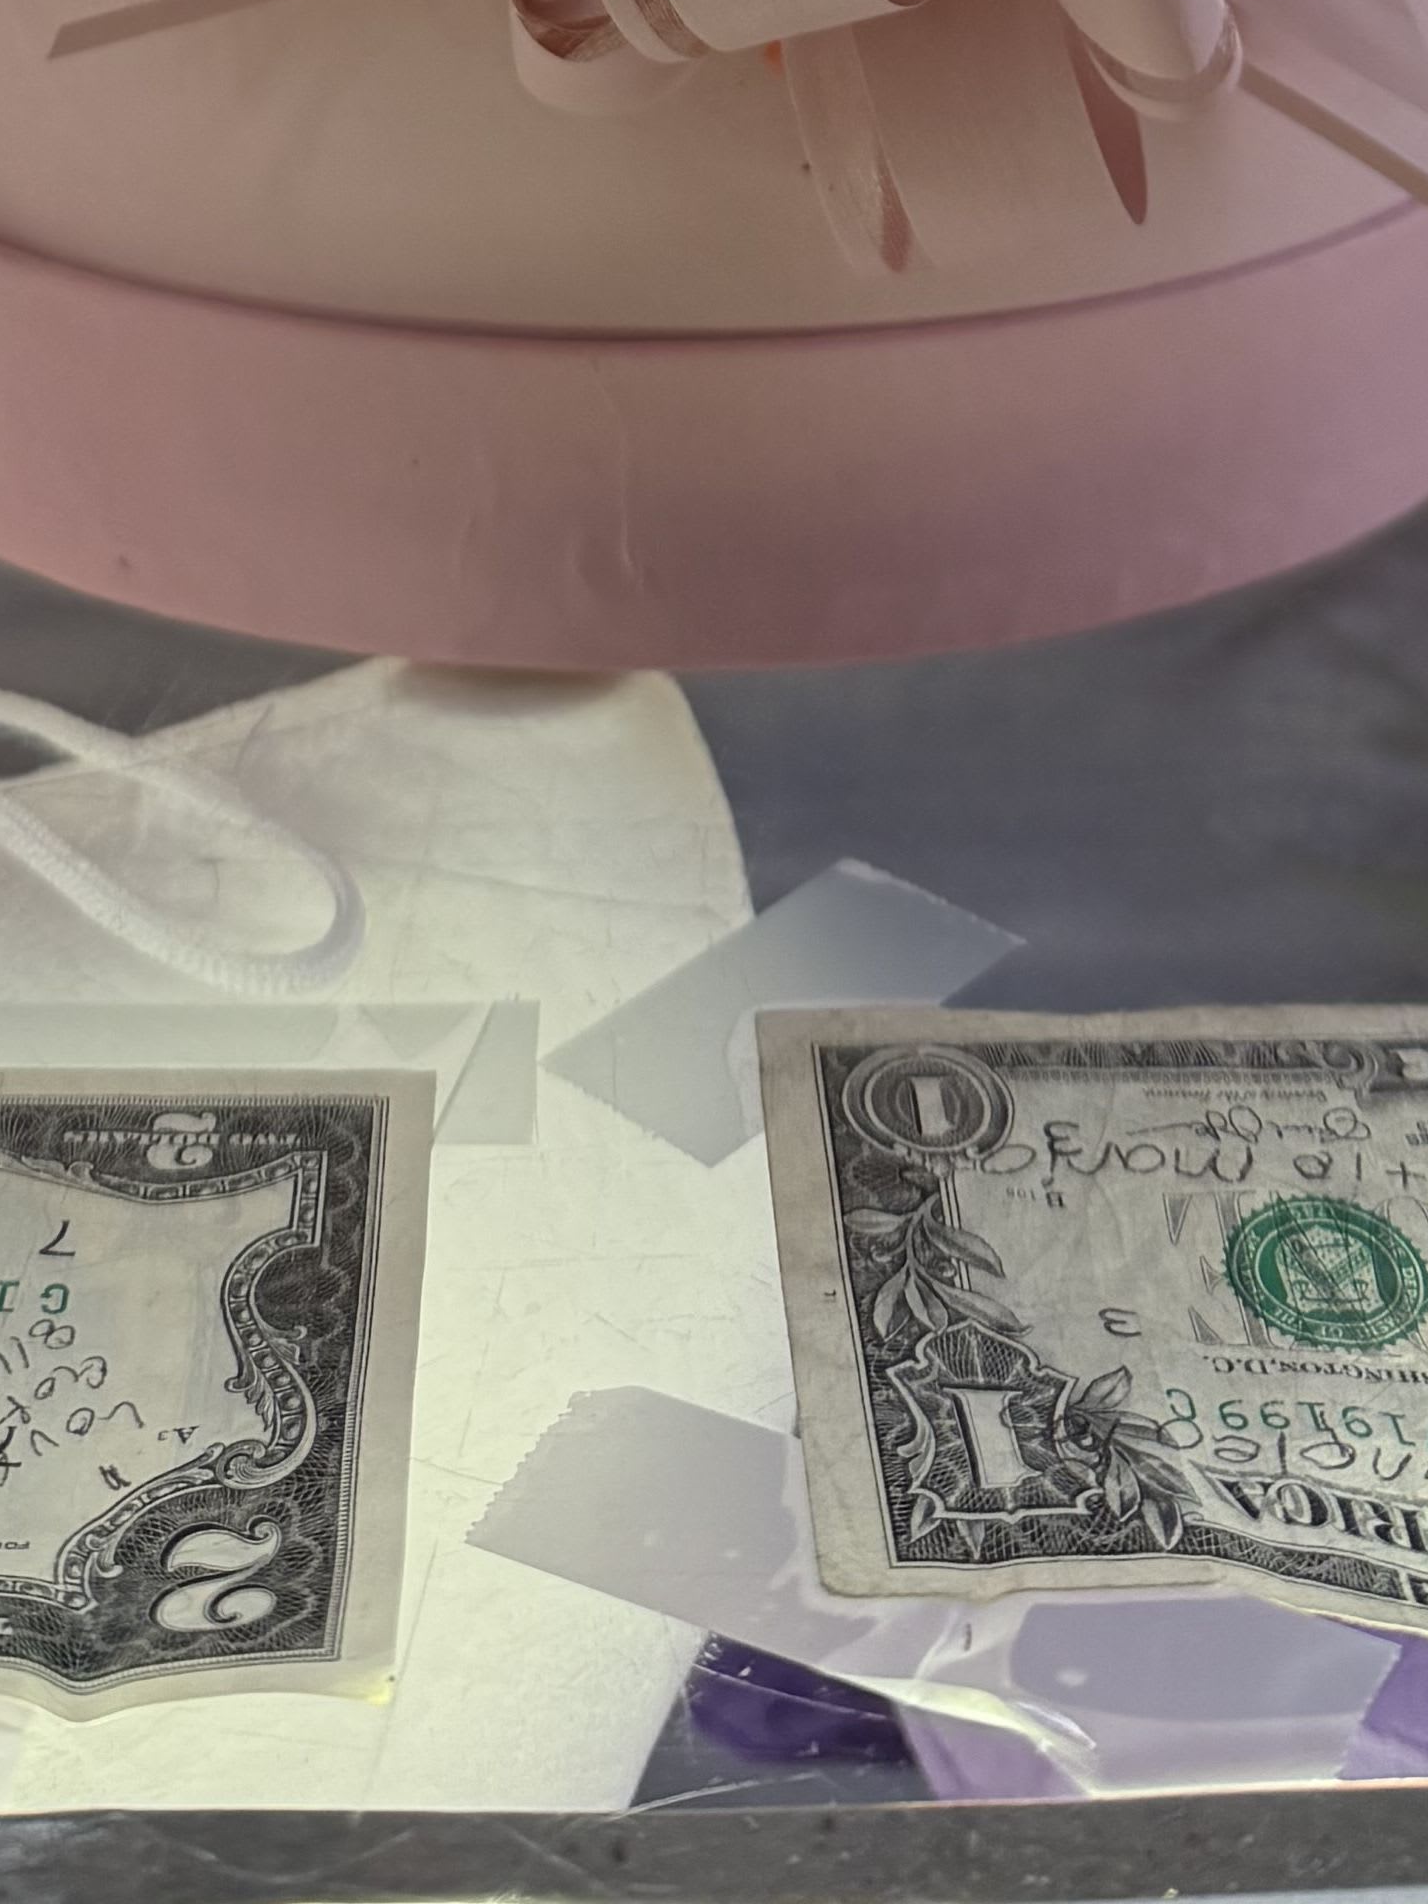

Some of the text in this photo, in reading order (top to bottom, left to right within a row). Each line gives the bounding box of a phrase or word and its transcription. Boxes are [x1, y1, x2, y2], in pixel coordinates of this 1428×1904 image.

[146, 1111, 217, 1171] 2
[38, 1219, 76, 1258] 7
[1097, 1307, 1143, 1338] 3
[942, 1386, 1044, 1490] 1
[148, 1514, 282, 1632] 2
